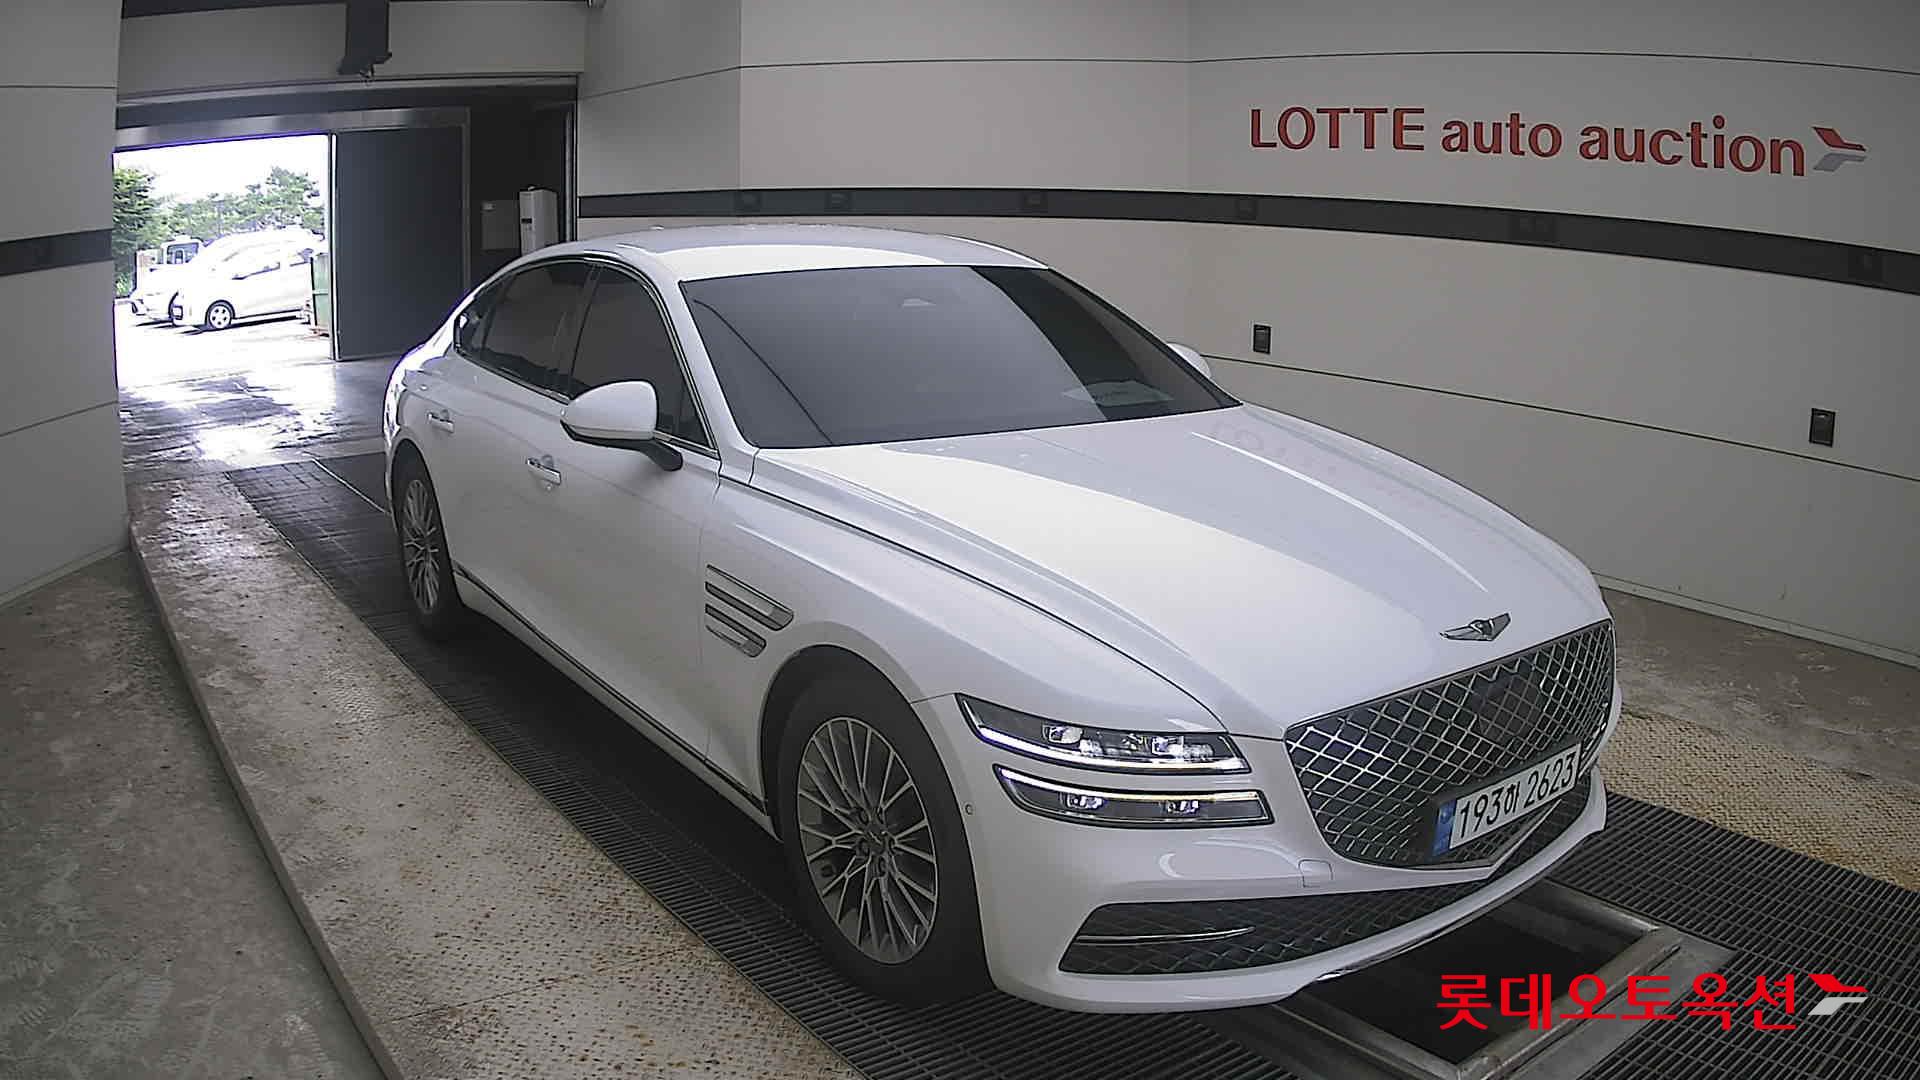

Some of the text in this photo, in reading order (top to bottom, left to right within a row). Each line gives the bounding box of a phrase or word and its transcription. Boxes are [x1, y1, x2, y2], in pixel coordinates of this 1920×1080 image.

[1251, 107, 1806, 176] LOTTE auto auction
[1460, 750, 1577, 839] 193하 2623
